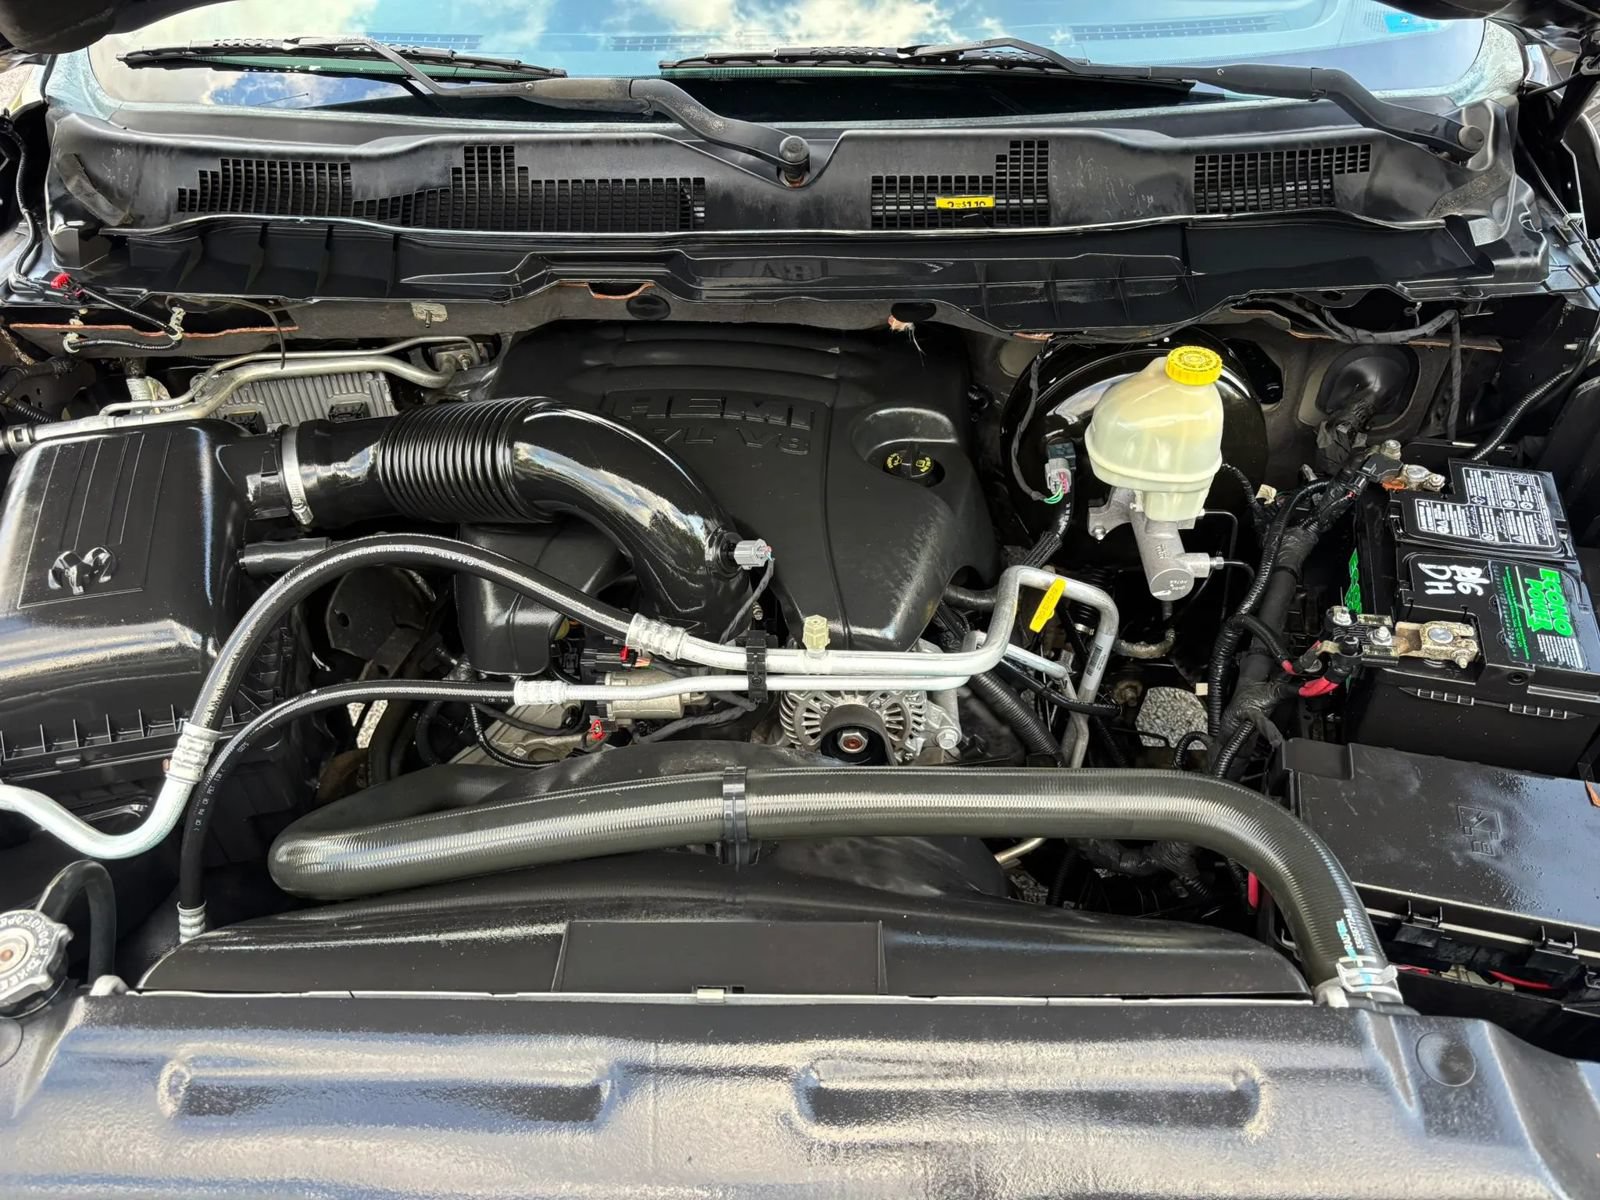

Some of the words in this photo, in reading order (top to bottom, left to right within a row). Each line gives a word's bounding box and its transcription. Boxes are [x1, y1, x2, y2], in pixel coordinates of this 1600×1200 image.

[1418, 562, 1456, 595] DH
[1524, 578, 1554, 632] POWER
[1539, 568, 1574, 637] ECONO
